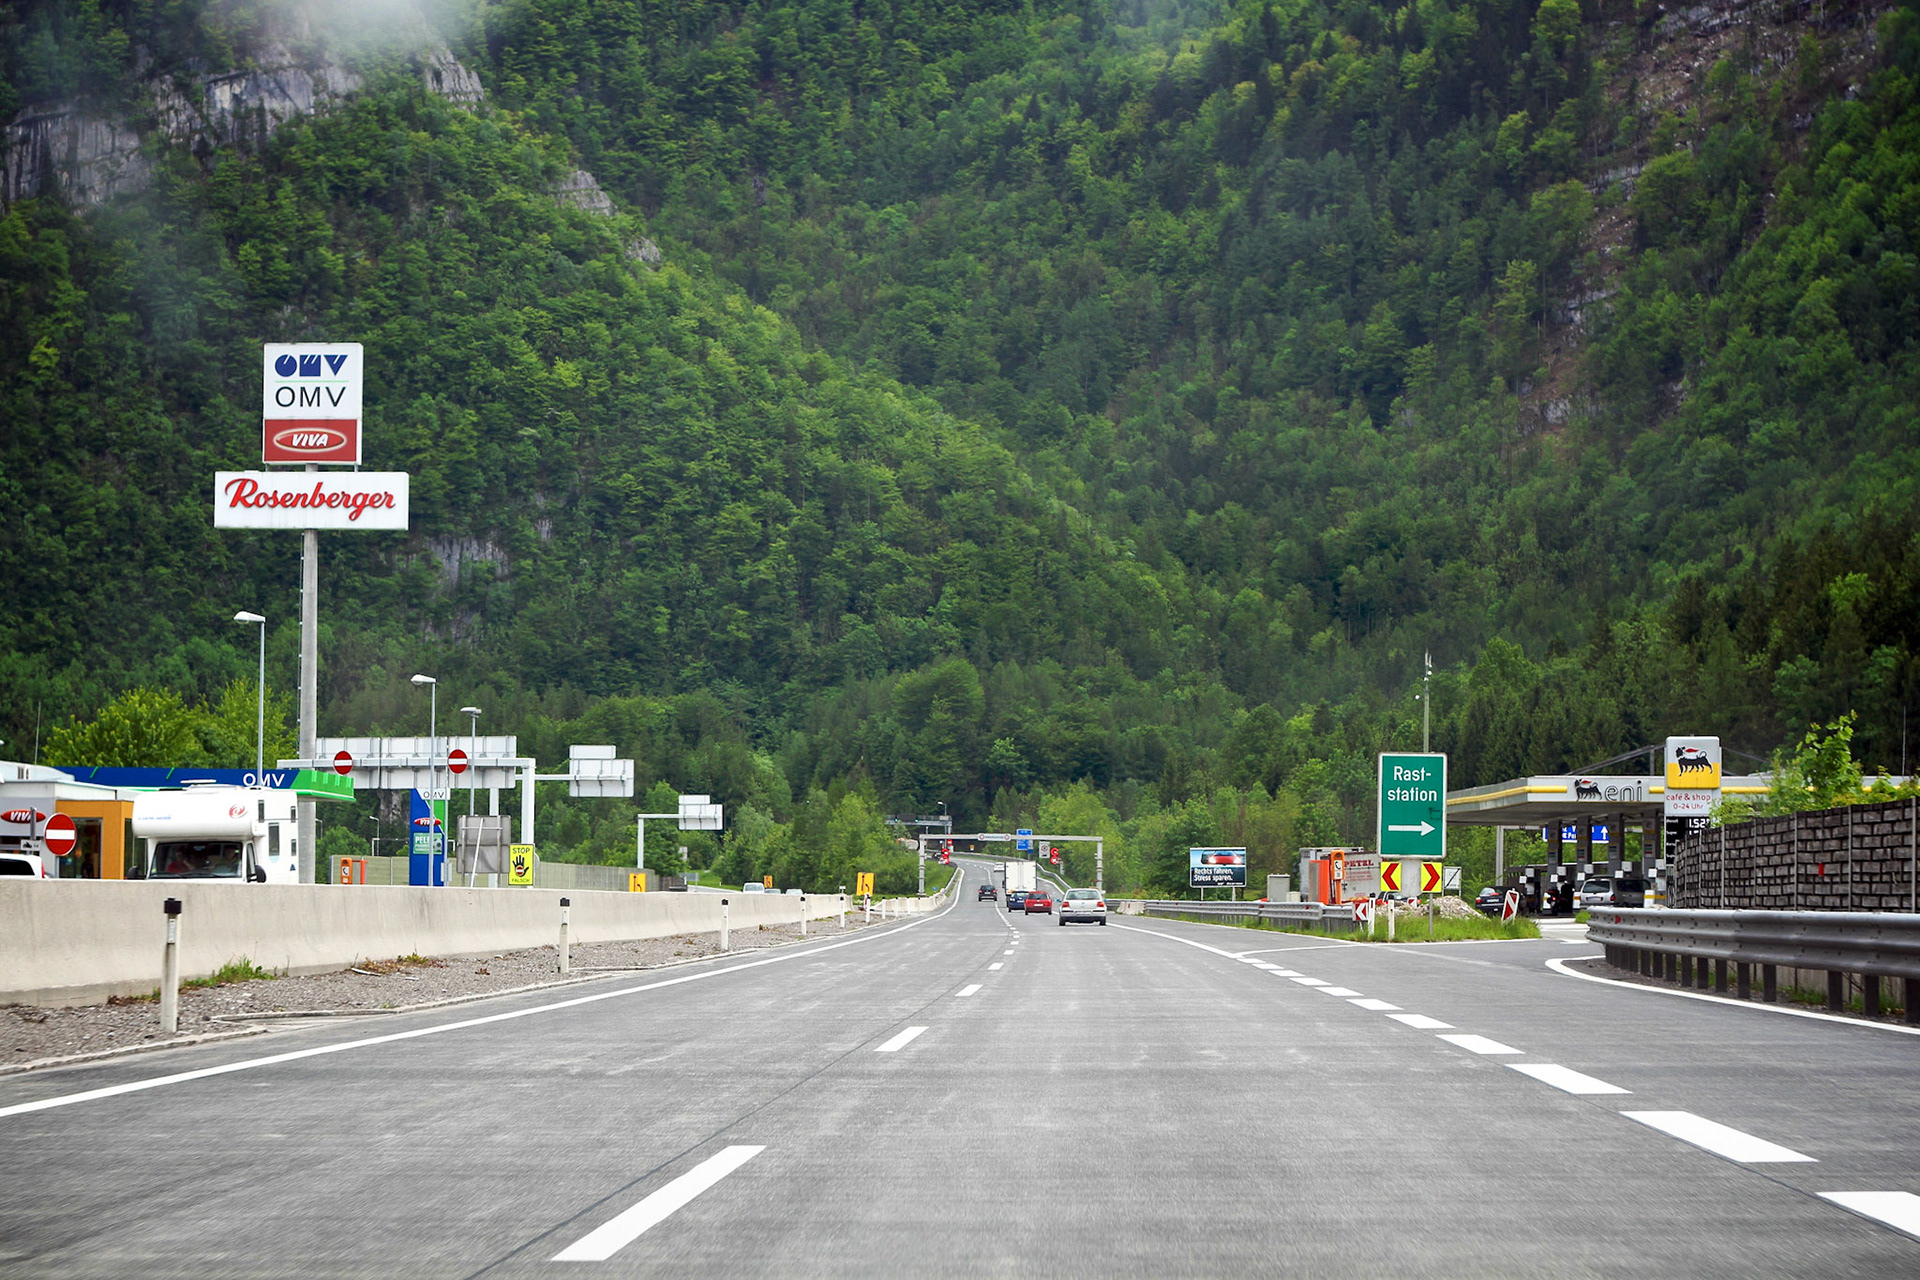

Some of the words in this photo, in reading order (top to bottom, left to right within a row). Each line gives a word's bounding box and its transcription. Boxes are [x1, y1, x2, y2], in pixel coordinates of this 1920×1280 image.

[275, 386, 347, 407] OMV
[292, 433, 329, 447] VIVA
[225, 478, 396, 521] Rosenberger
[1393, 766, 1432, 781] Rast-
[1387, 787, 1438, 802] station
[1605, 780, 1642, 801] eni
[1684, 793, 1690, 801] &
[1692, 793, 1711, 803] shop
[1194, 867, 1213, 875] Rechts
[1194, 874, 1212, 882] Stress
